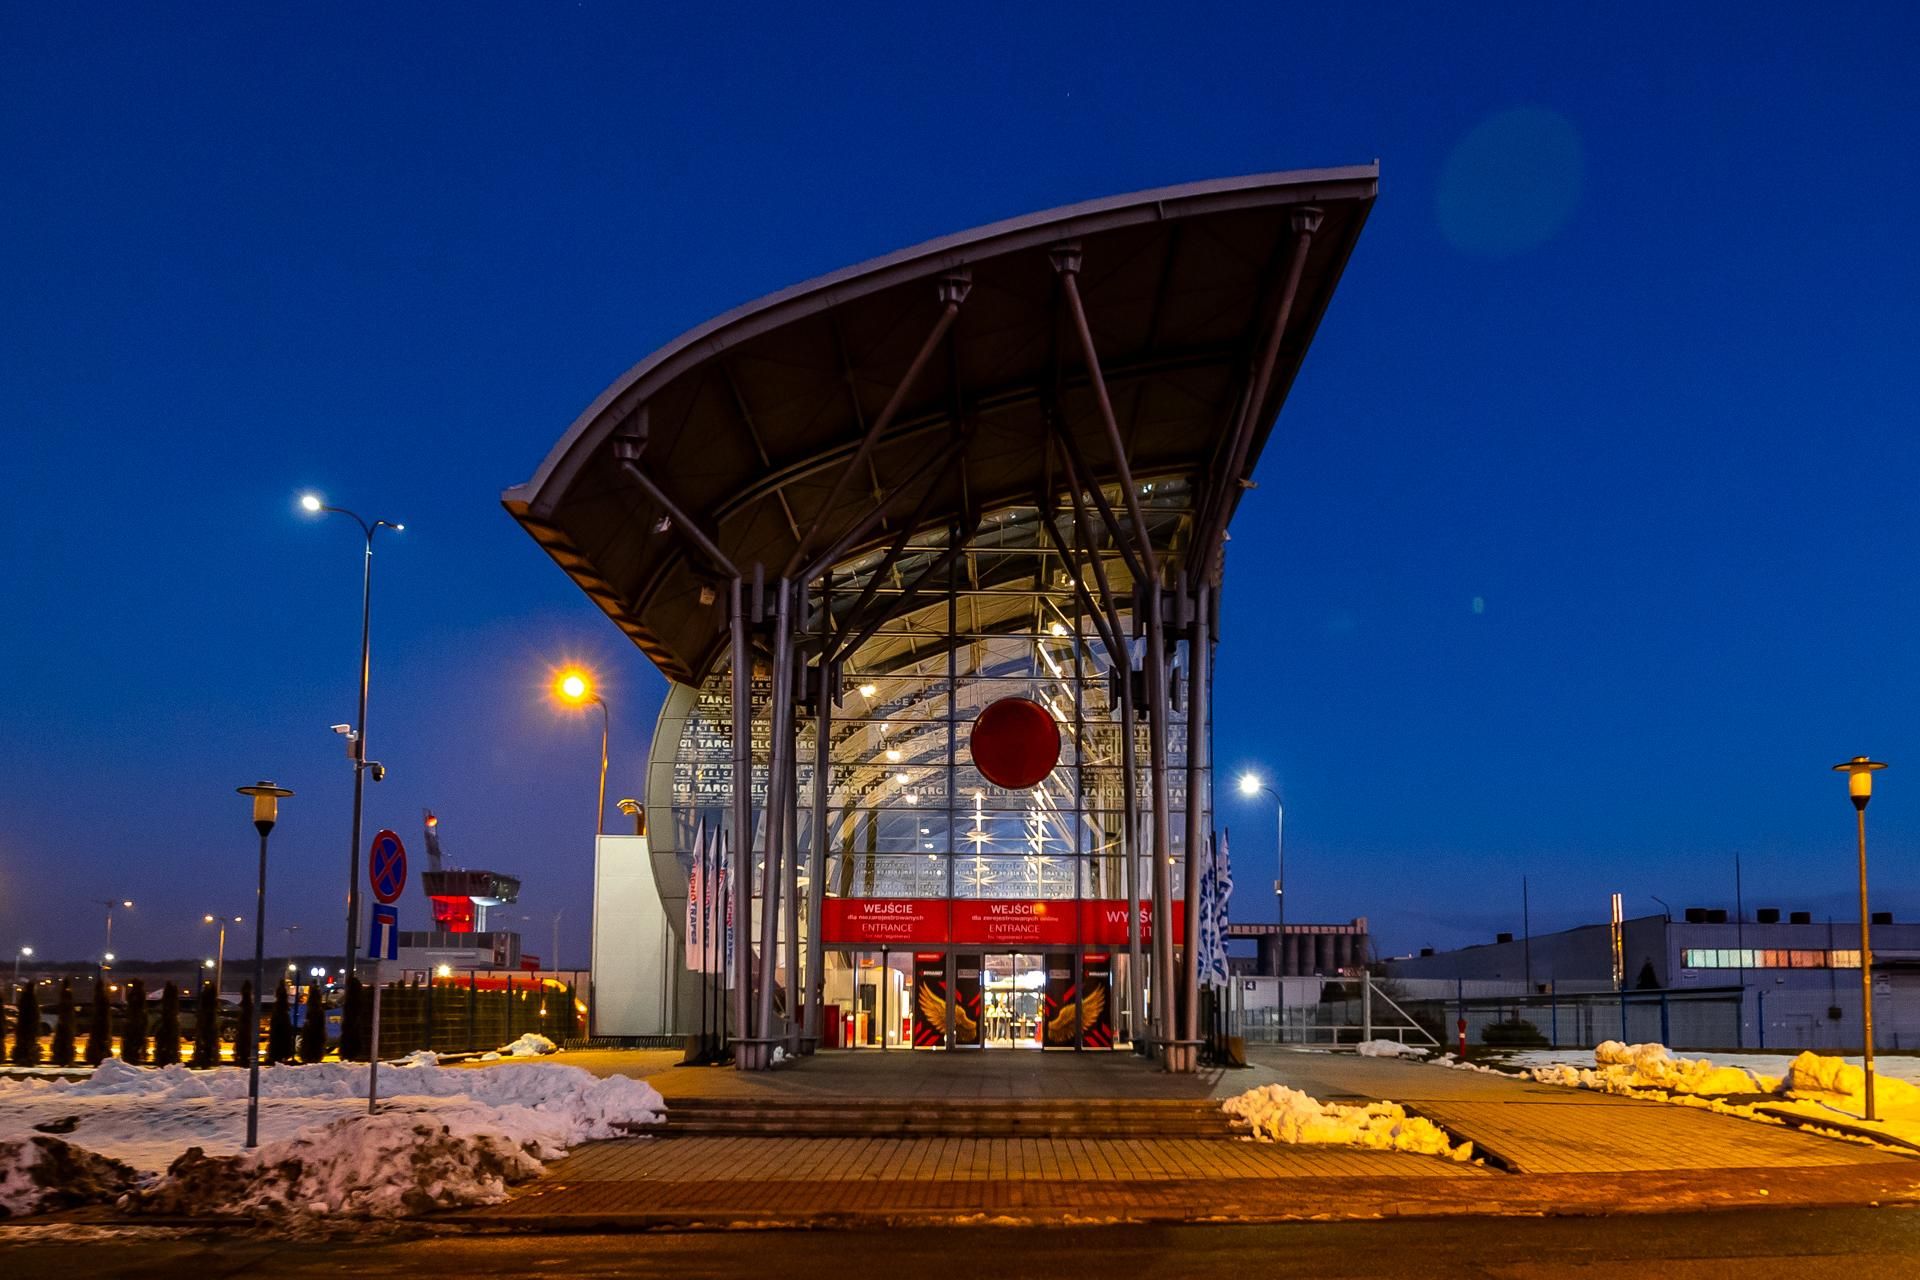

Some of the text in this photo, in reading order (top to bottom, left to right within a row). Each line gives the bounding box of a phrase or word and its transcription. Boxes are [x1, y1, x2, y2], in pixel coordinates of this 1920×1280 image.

[700, 695, 732, 704] TARG
[864, 902, 913, 914] WEJŚCIE
[862, 923, 913, 932] ENTRANCE
[989, 924, 1040, 933] ENTRANCE
[417, 974, 423, 982] 7
